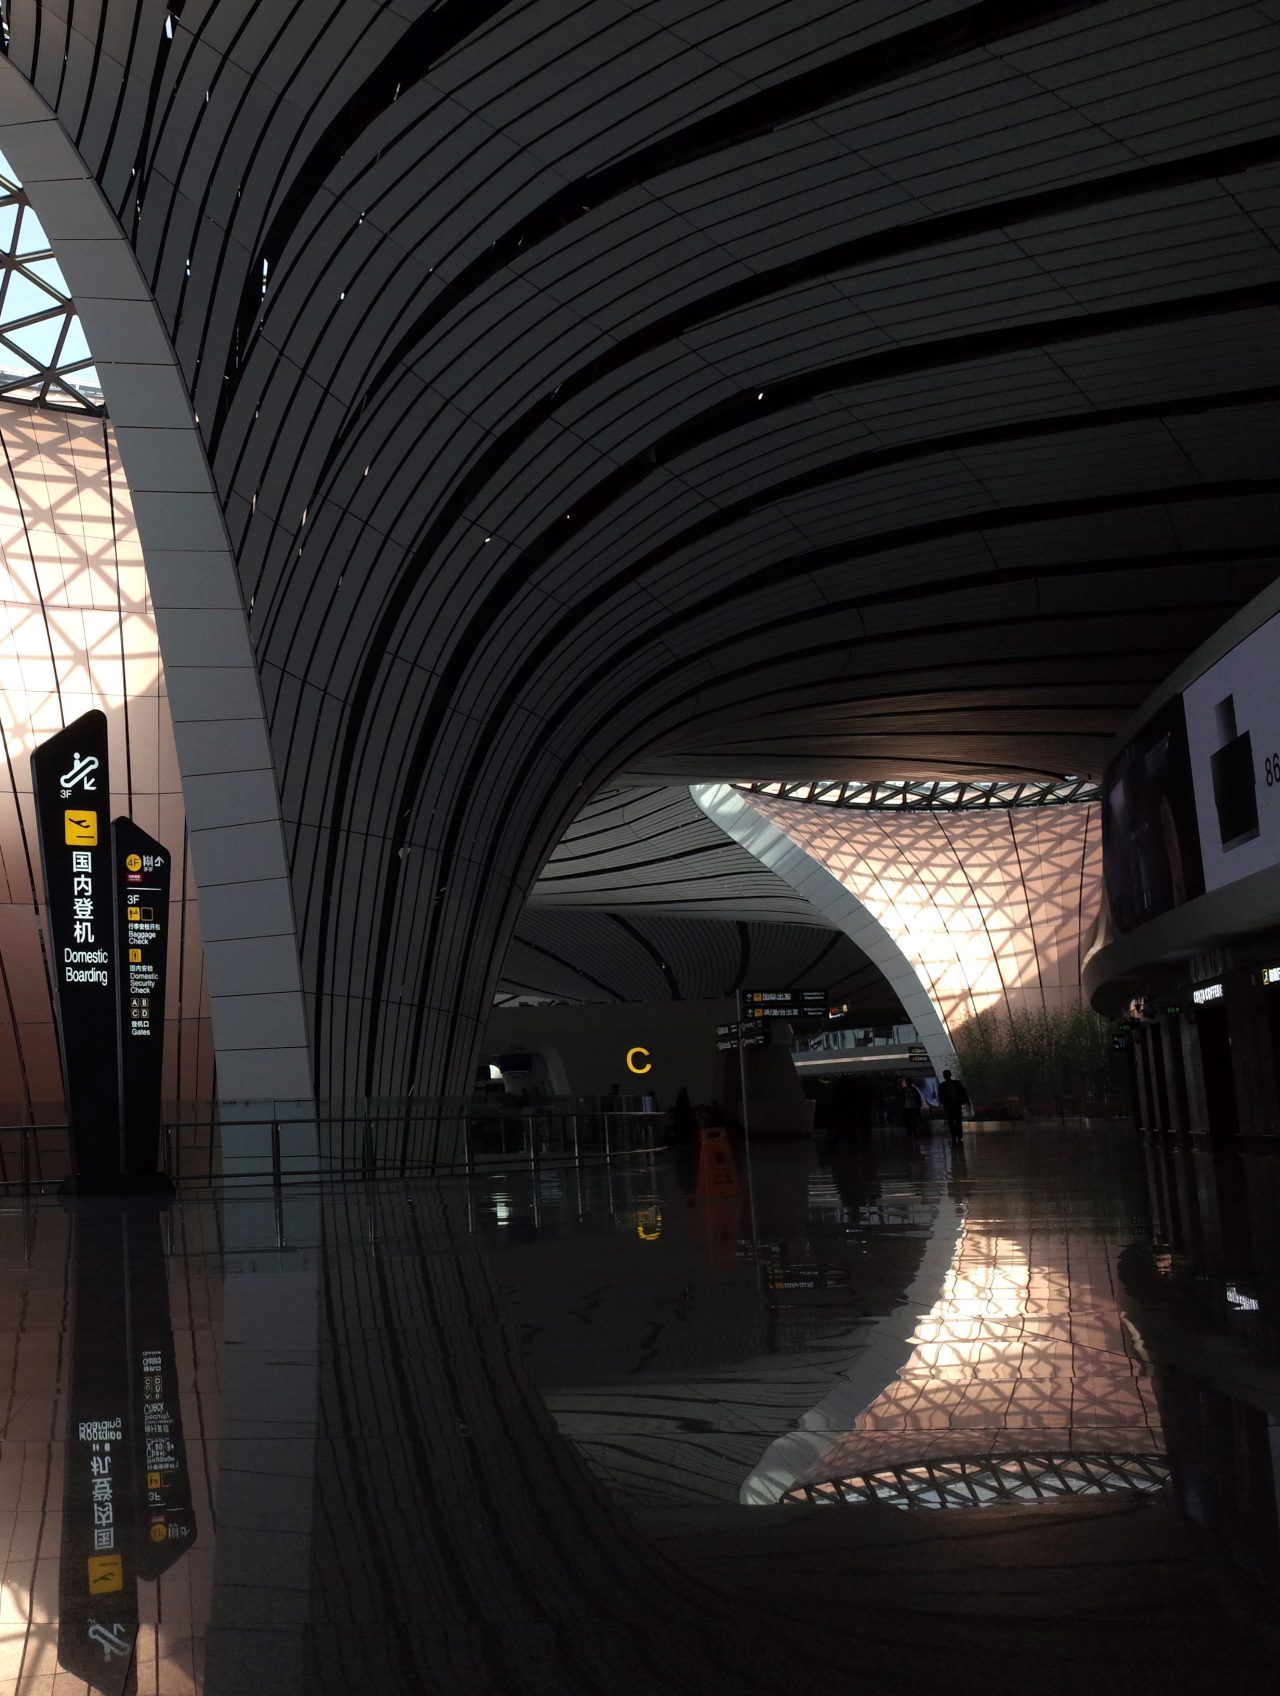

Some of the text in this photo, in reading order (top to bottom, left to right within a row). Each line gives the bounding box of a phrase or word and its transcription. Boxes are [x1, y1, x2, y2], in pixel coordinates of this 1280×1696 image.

[60, 789, 72, 798] 3F
[127, 858, 140, 868] 4F
[72, 851, 95, 943] 国内登机
[126, 894, 140, 905] 3F
[128, 930, 157, 940] Baggage
[128, 937, 149, 945] Check
[64, 947, 108, 964] Domestic
[65, 966, 108, 986] Boarding
[129, 972, 159, 980] Domestic
[130, 979, 156, 989] Security
[130, 986, 151, 994] Check
[131, 1028, 151, 1036] Gates
[626, 1046, 652, 1075] C
